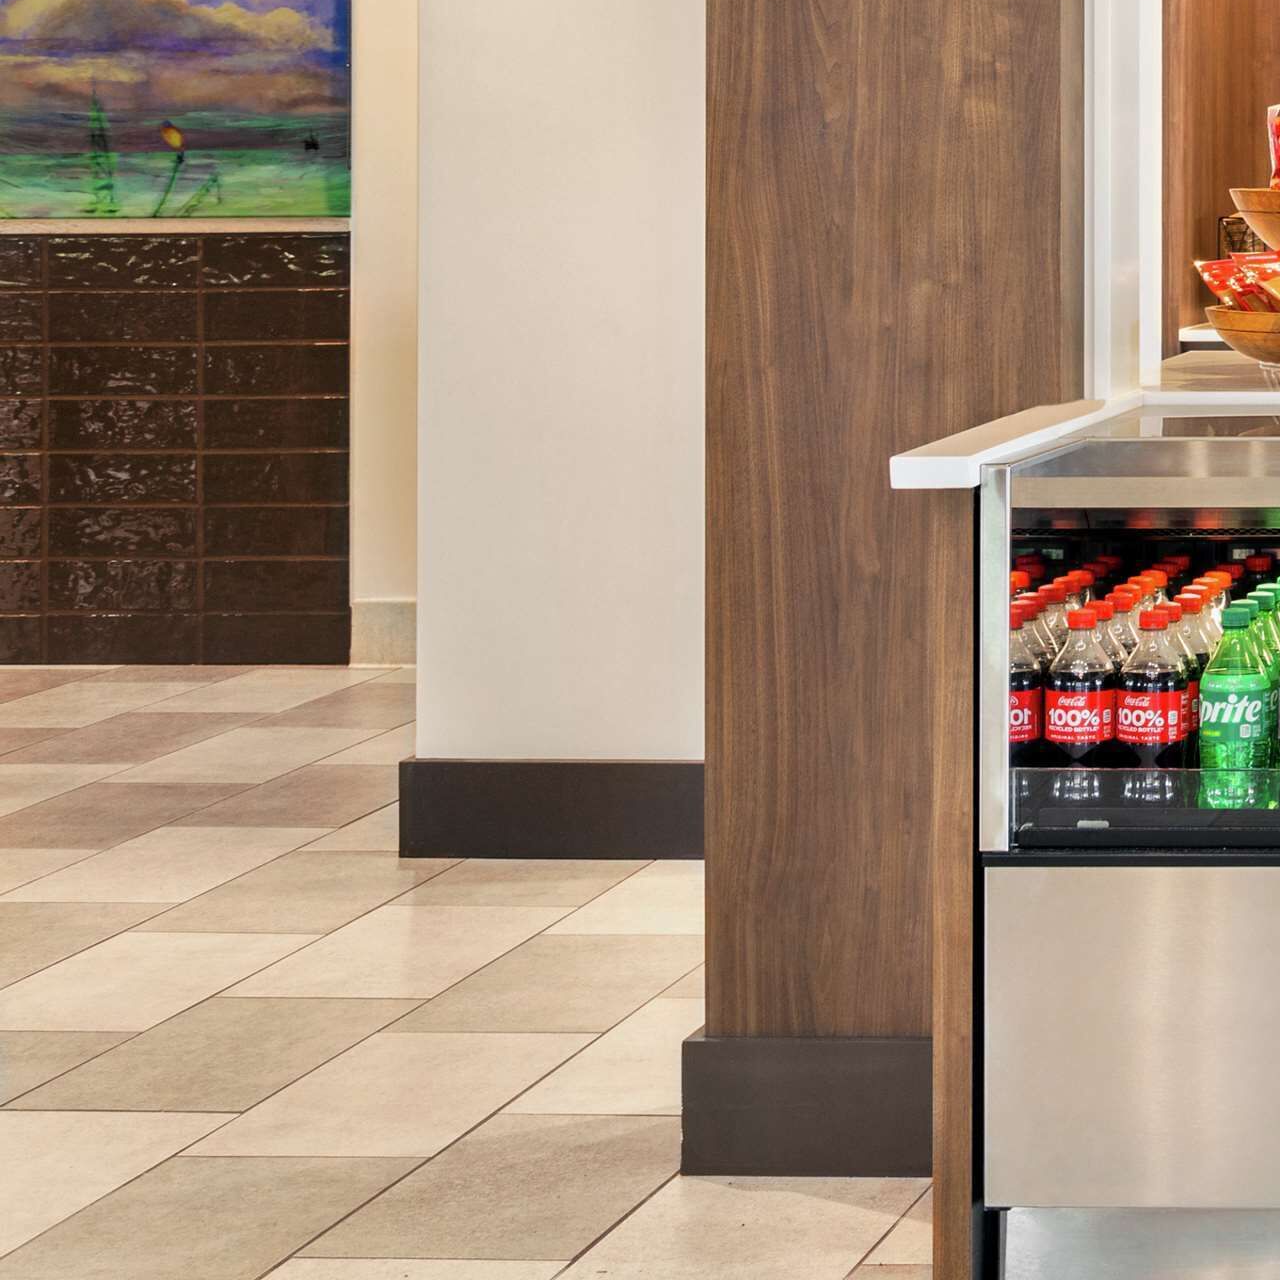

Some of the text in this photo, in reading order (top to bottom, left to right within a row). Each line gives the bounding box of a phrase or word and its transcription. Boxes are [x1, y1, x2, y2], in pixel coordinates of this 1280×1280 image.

[1058, 696, 1087, 706] Coca-Cola
[1125, 696, 1151, 707] Coca-Cola
[1049, 708, 1101, 726] 100%
[1118, 709, 1165, 727] 100%
